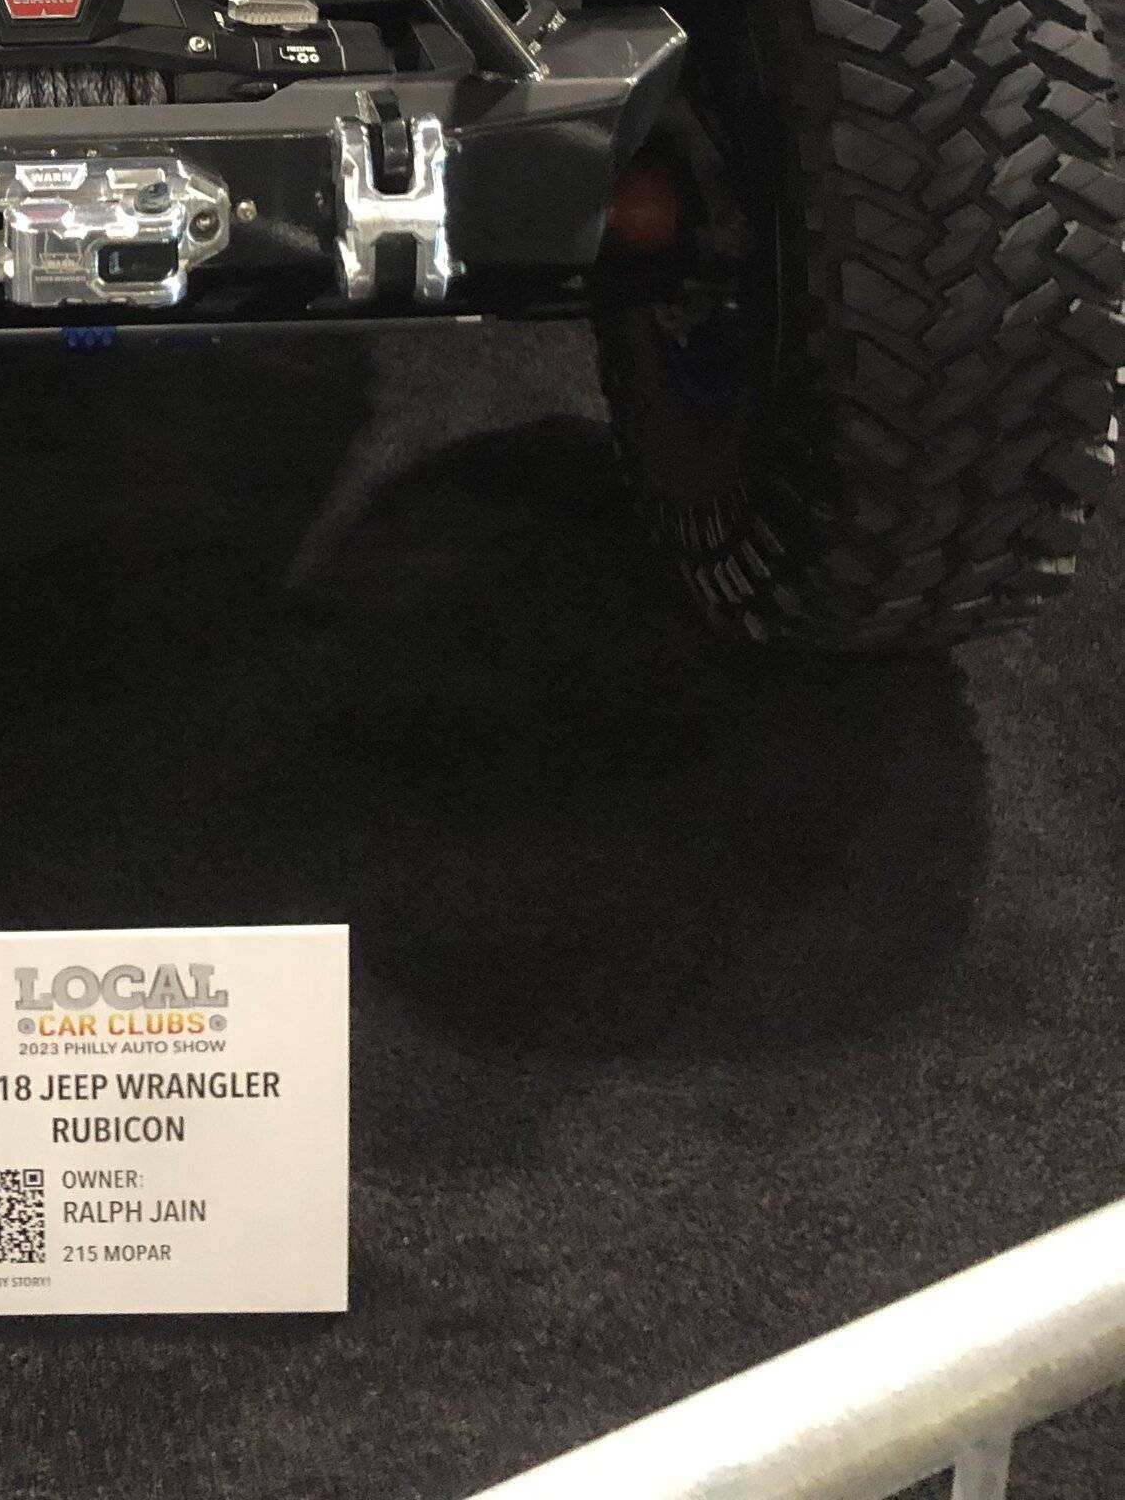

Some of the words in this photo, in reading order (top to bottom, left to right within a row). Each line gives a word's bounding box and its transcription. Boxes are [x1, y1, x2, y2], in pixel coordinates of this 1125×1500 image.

[30, 171, 73, 183] WARN
[14, 963, 229, 1011] LOCAL
[38, 1015, 97, 1037] CAR
[107, 1012, 206, 1036] CLUBS
[18, 1042, 59, 1056] 2023
[64, 1041, 117, 1055] PHILLY
[120, 1040, 168, 1054] AUTO
[173, 1039, 227, 1053] SHOW
[39, 1074, 108, 1101] JEEP
[116, 1071, 281, 1100] WRANGLER
[51, 1115, 186, 1143] RUBICON
[61, 1169, 145, 1190] OWNER:
[63, 1199, 143, 1223] RALPH
[149, 1198, 206, 1223] JAIN
[63, 1245, 99, 1263] 215
[103, 1243, 172, 1262] MOPAR
[11, 1276, 51, 1288] STORY!
